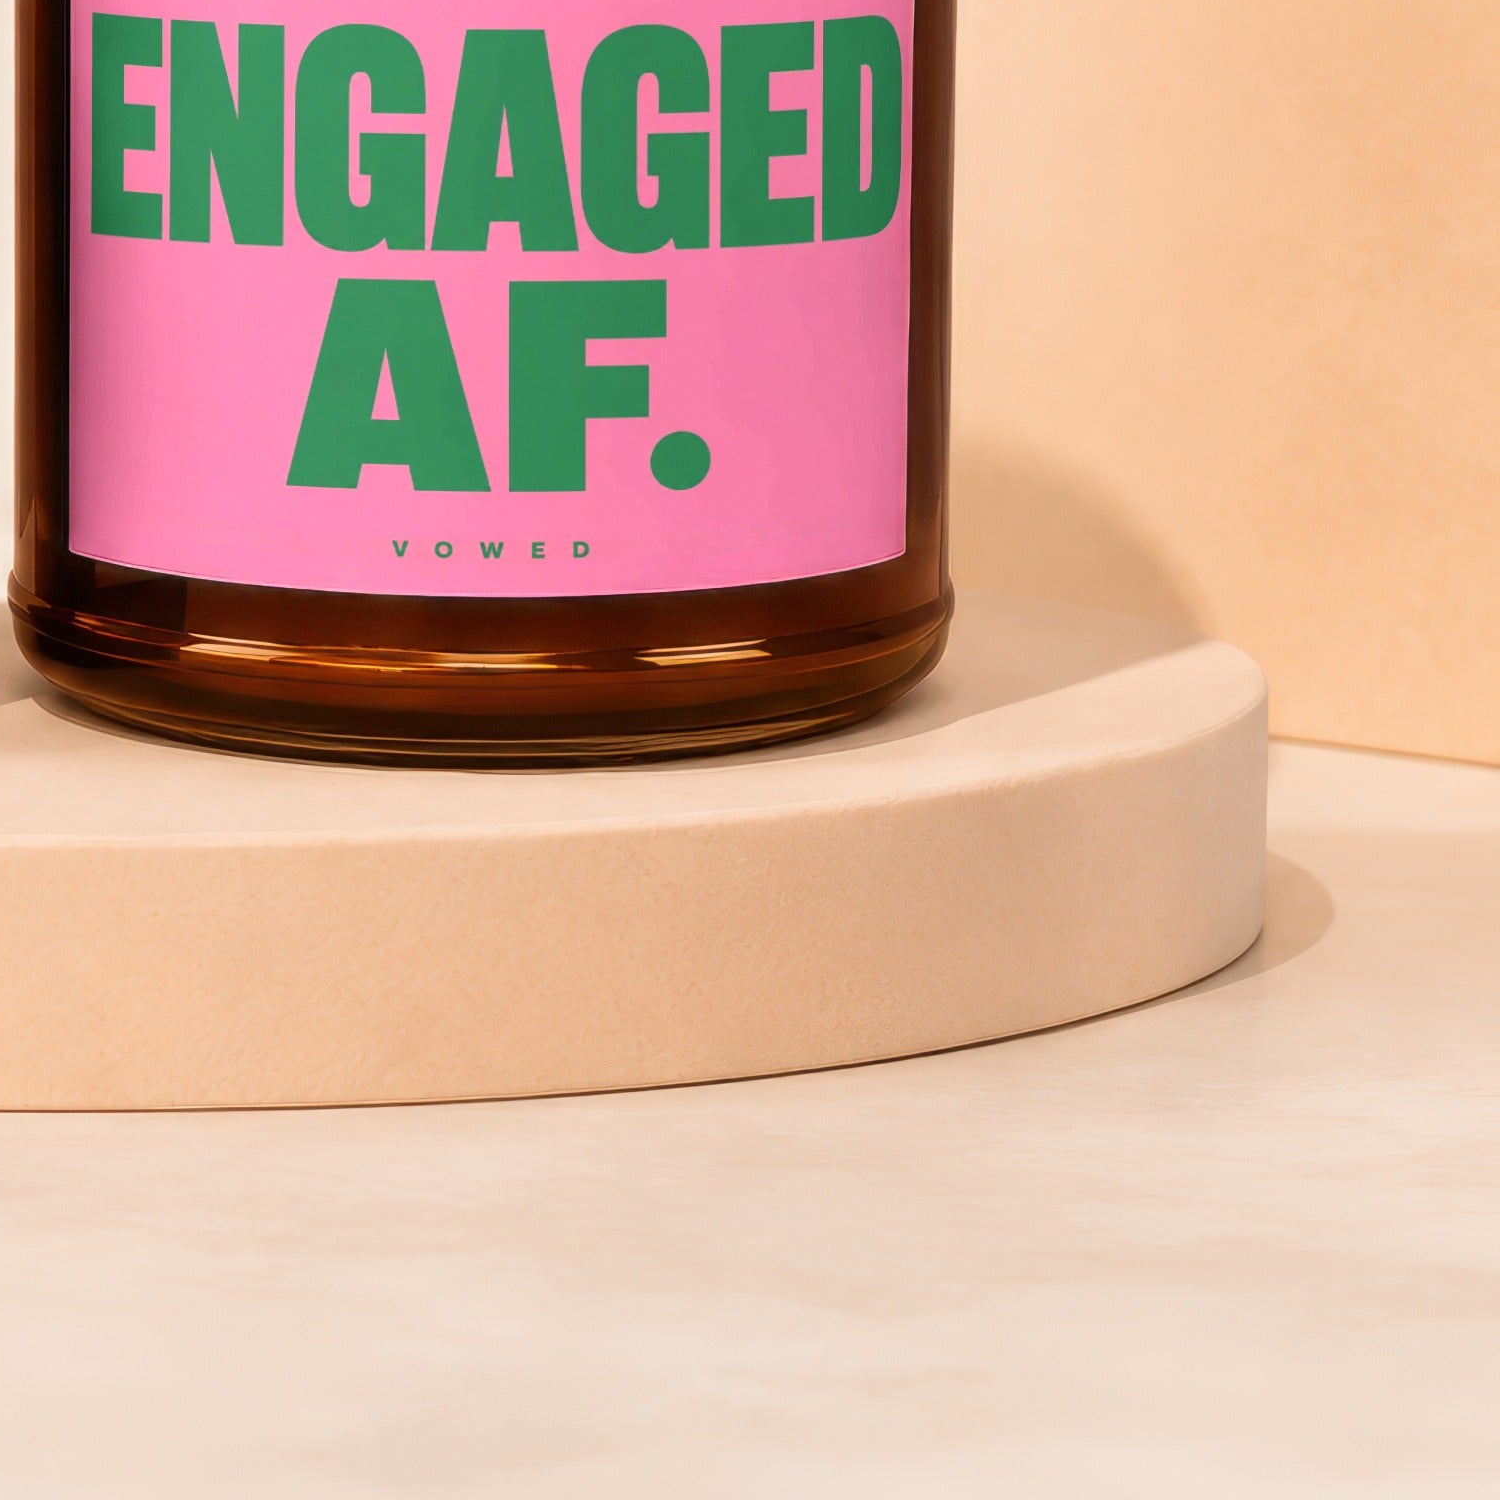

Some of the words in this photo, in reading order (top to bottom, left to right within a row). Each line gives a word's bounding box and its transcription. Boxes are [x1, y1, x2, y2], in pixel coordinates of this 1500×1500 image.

[91, 13, 903, 254] ENGAGED
[286, 279, 711, 492] AF.
[391, 540, 590, 559] VOWED
